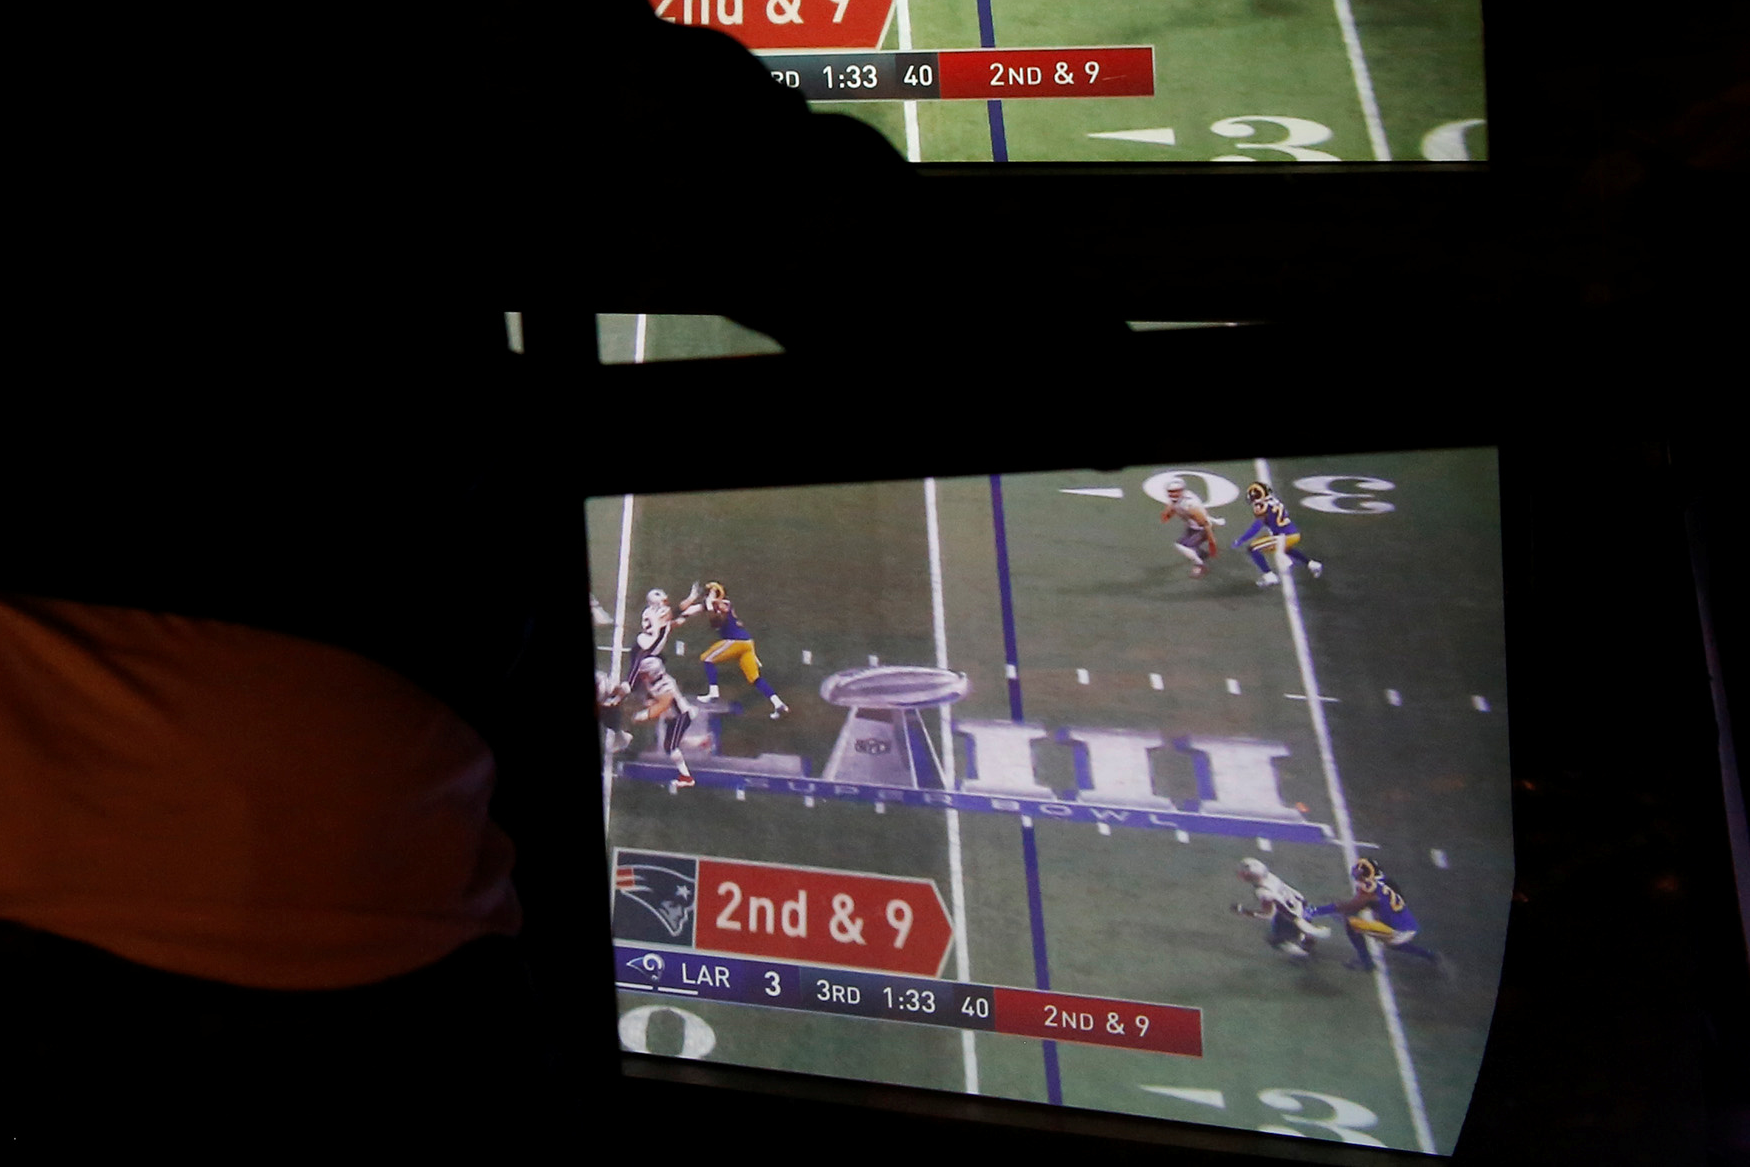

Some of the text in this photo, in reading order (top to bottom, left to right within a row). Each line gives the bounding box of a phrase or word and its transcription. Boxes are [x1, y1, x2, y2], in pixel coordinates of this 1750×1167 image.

[770, 61, 1101, 90] RD 1:33 40 2ND & 9
[991, 797, 1181, 829] BOWL
[716, 881, 914, 950] 2nd & 9
[682, 962, 1151, 1037] LAR 3 3RD 1:33 40 2ND & 9
